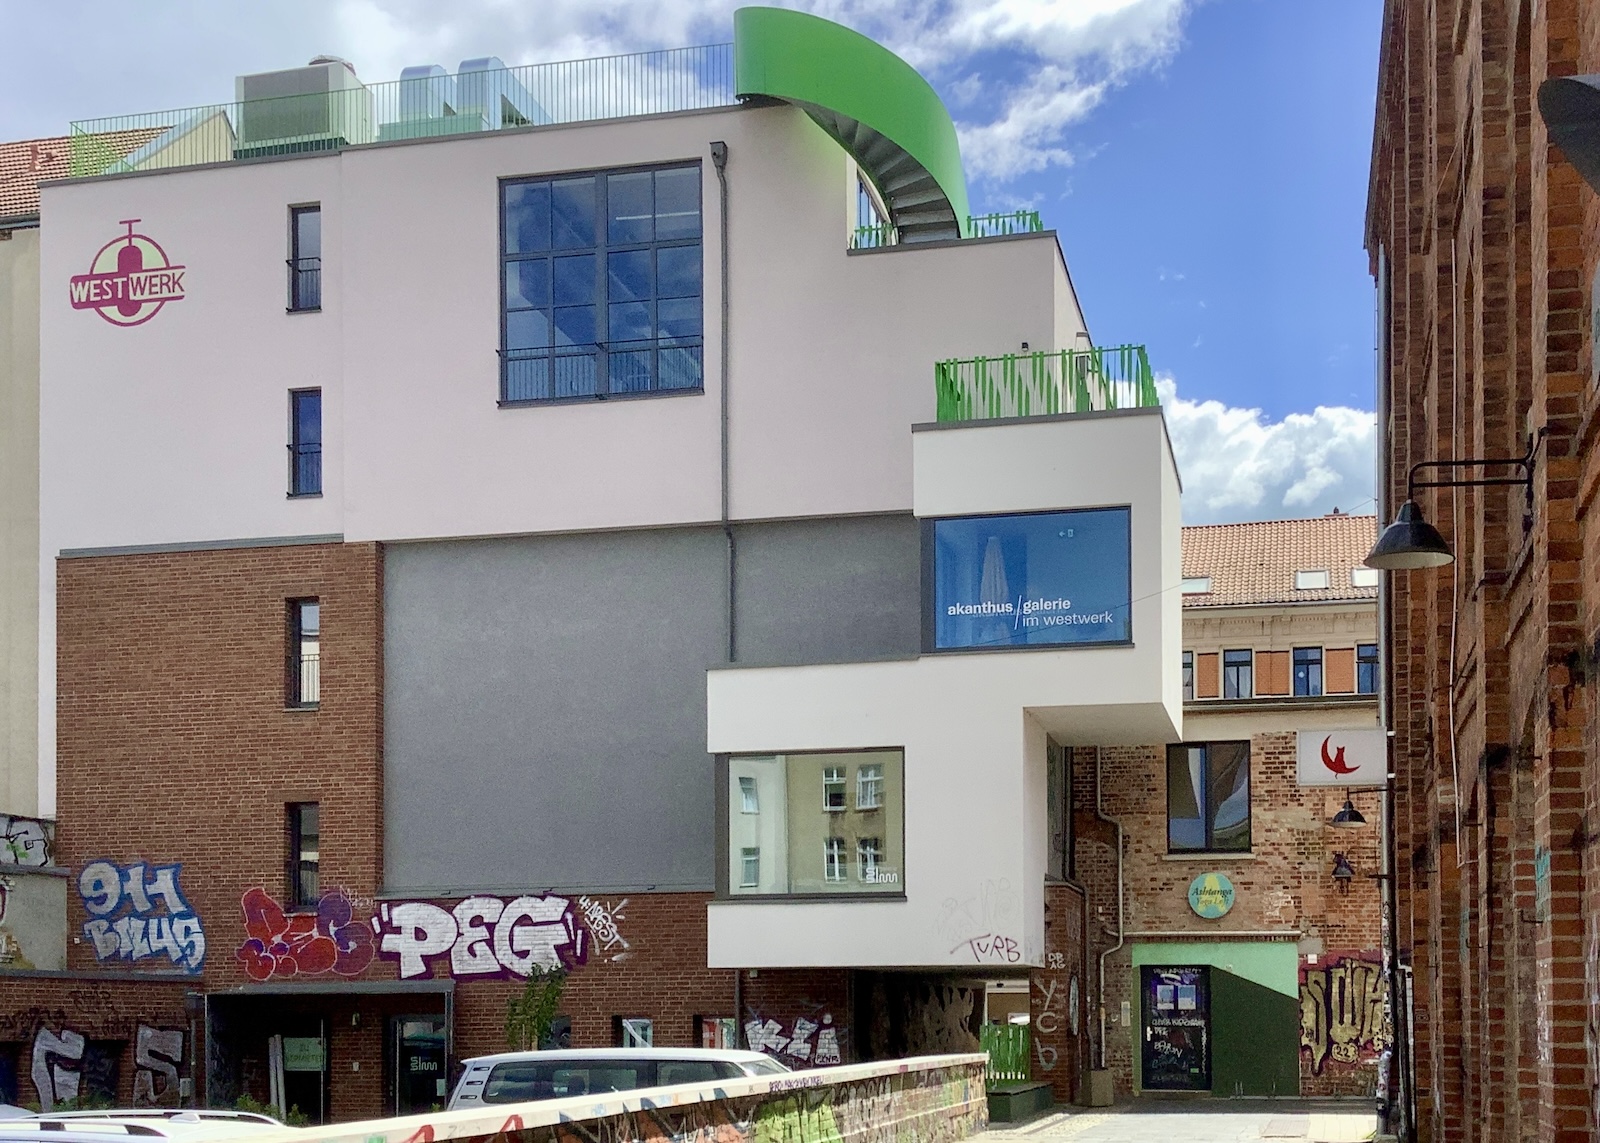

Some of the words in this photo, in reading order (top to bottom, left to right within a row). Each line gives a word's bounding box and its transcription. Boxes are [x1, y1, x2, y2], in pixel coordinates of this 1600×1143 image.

[70, 271, 186, 303] WESTWERK
[947, 601, 1014, 616] akanthus
[1023, 597, 1071, 614] galerie
[1022, 613, 1039, 627] im
[1043, 611, 1114, 626] westwerk
[380, 894, 571, 980] PEG
[949, 933, 1021, 963] TURB
